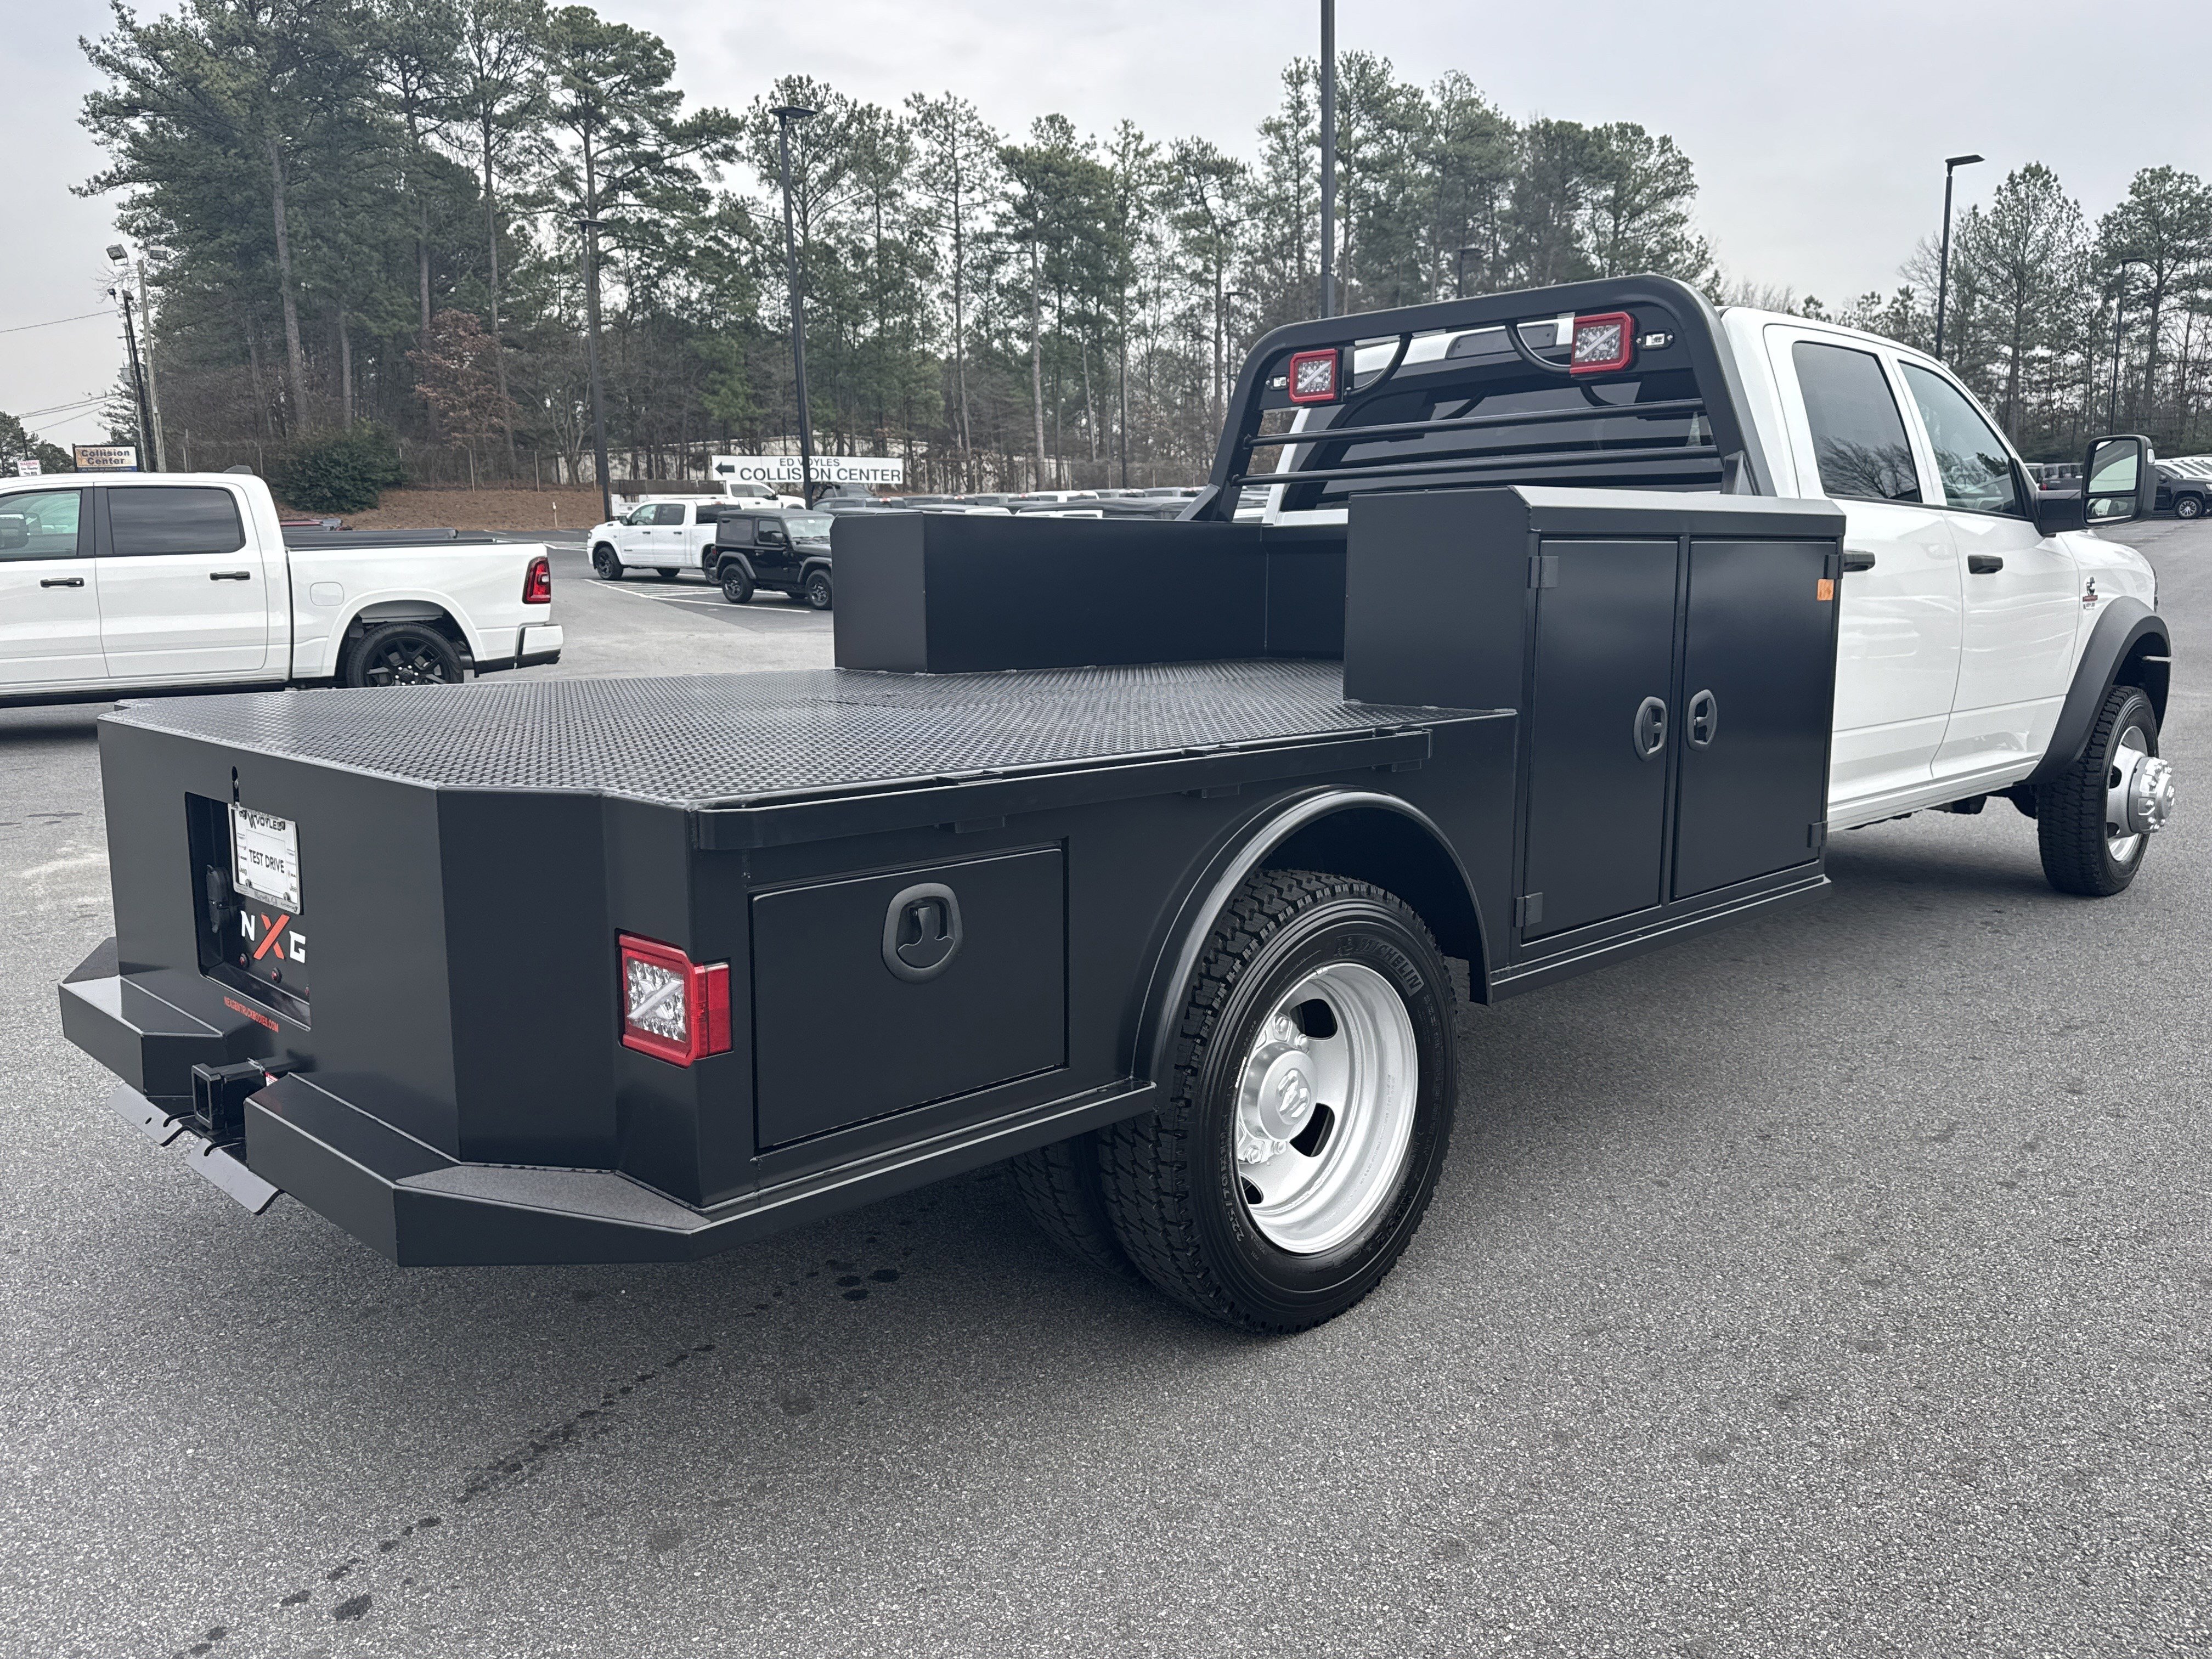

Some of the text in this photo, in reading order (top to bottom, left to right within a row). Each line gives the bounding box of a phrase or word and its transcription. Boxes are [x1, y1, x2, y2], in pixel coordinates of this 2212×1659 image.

[780, 458, 794, 466] ED
[740, 467, 900, 481] COLLISON CENTER
[254, 815, 284, 831] VOYLE
[249, 849, 285, 873] TEST DRIVE
[240, 910, 306, 963] NXG
[1357, 937, 1423, 990] MICHELIN
